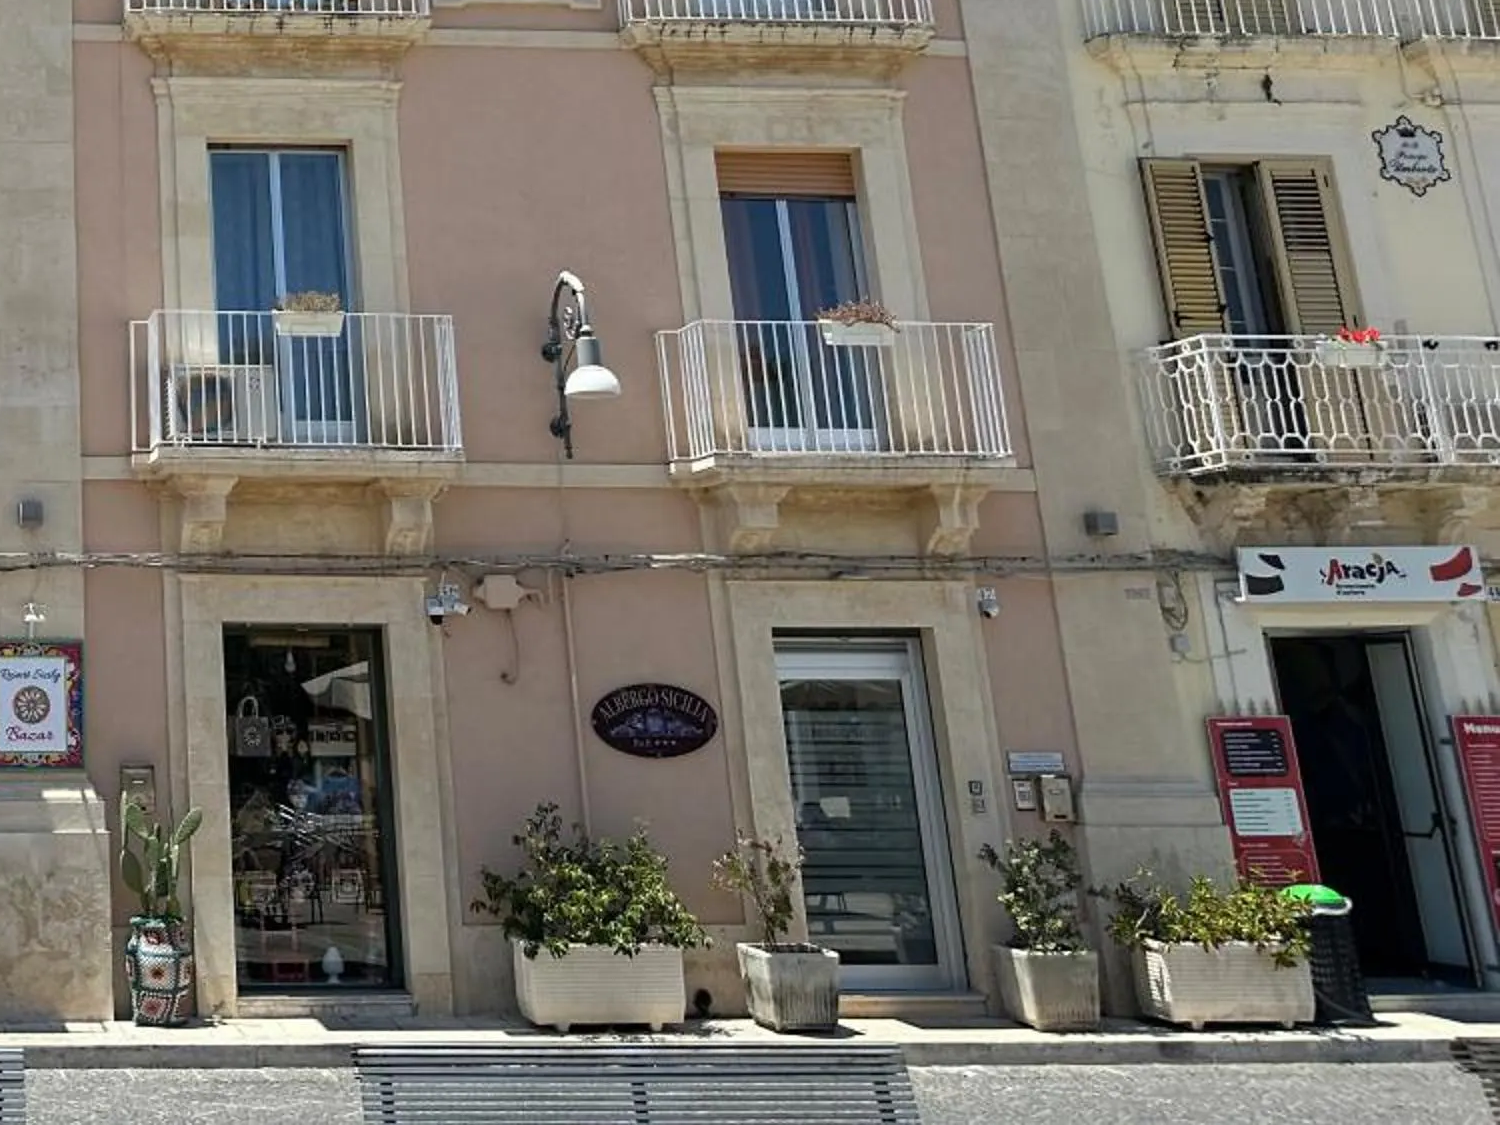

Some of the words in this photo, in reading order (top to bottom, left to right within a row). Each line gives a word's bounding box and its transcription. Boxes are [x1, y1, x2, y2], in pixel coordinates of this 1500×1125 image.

[600, 689, 660, 723] ALBERGO
[660, 689, 709, 723] SICILIA
[5, 726, 53, 741] Bazar
